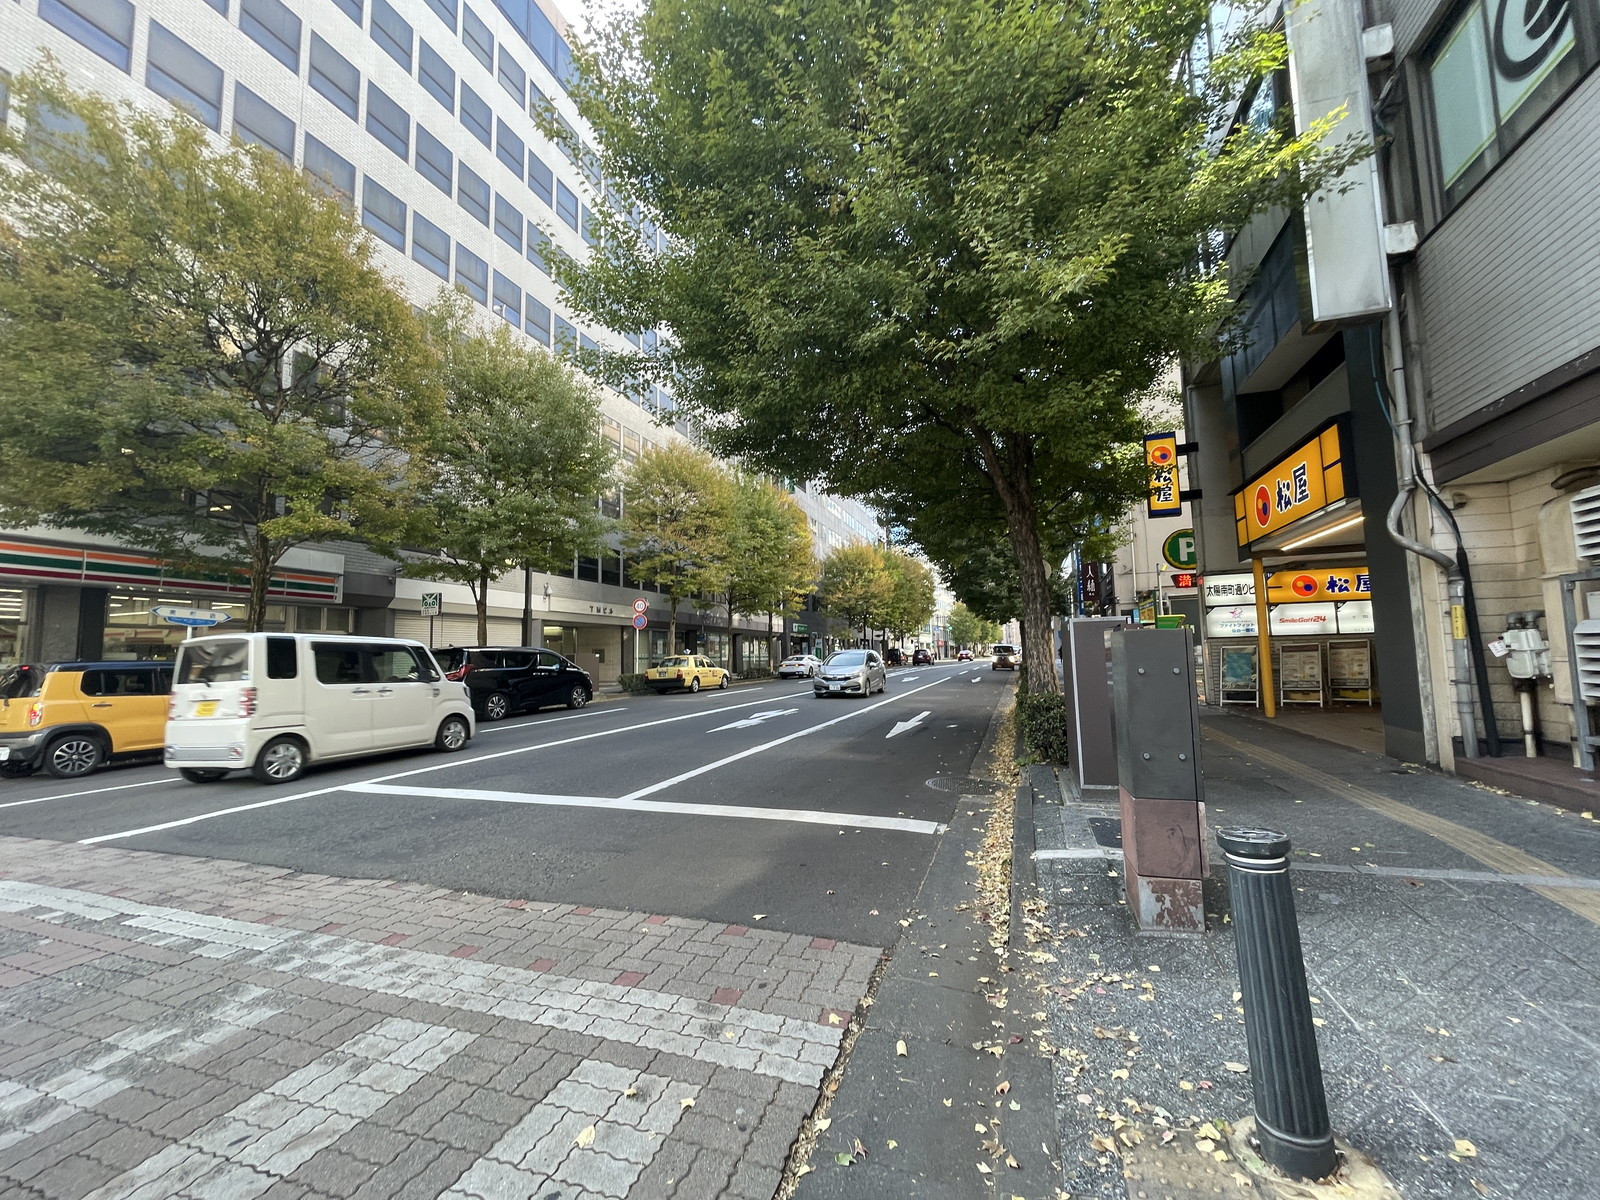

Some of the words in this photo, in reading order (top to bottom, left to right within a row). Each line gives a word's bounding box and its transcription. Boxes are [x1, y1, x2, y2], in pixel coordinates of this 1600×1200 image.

[1275, 461, 1310, 514] 松屋
[1178, 537, 1195, 562] P
[1178, 575, 1192, 587] 満
[1325, 574, 1371, 594] 松屋
[636, 602, 643, 610] 40
[1278, 615, 1327, 624] SmileGolf24
